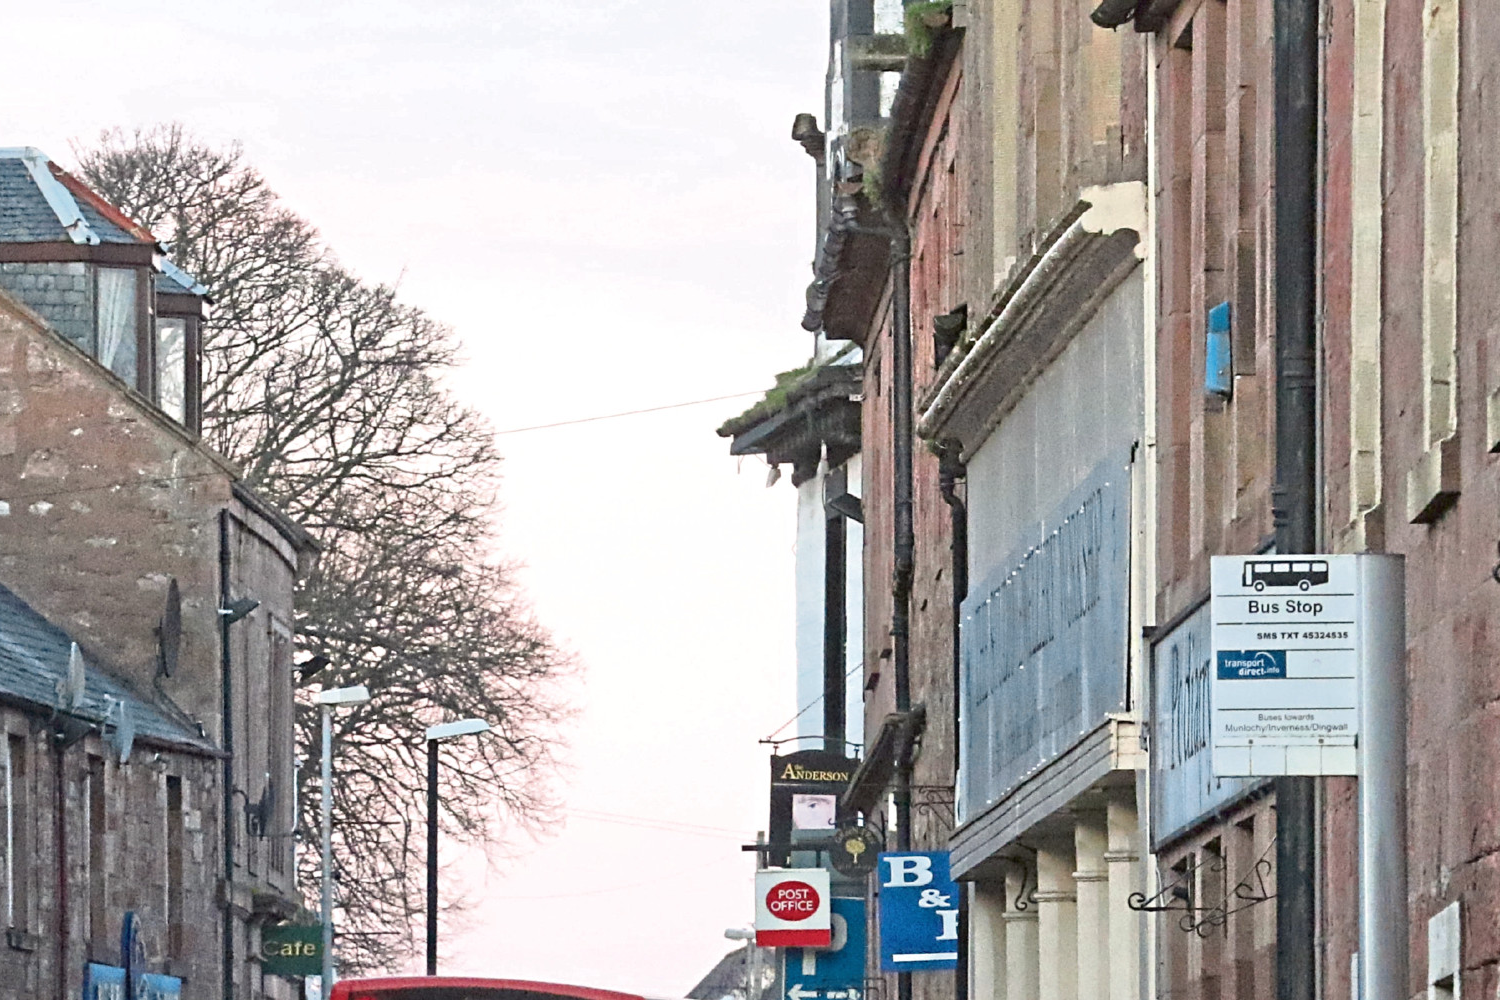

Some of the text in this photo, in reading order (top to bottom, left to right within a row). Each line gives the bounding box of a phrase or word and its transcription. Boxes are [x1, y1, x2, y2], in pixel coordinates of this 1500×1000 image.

[1248, 599, 1323, 616] Bus Stop
[1256, 632, 1278, 640] SMS
[1281, 631, 1299, 639] TXT
[1224, 659, 1265, 668] transport
[1258, 713, 1315, 721] Buses towards
[882, 855, 933, 888] B
[778, 888, 809, 901] POST
[770, 899, 814, 912] OFFICE
